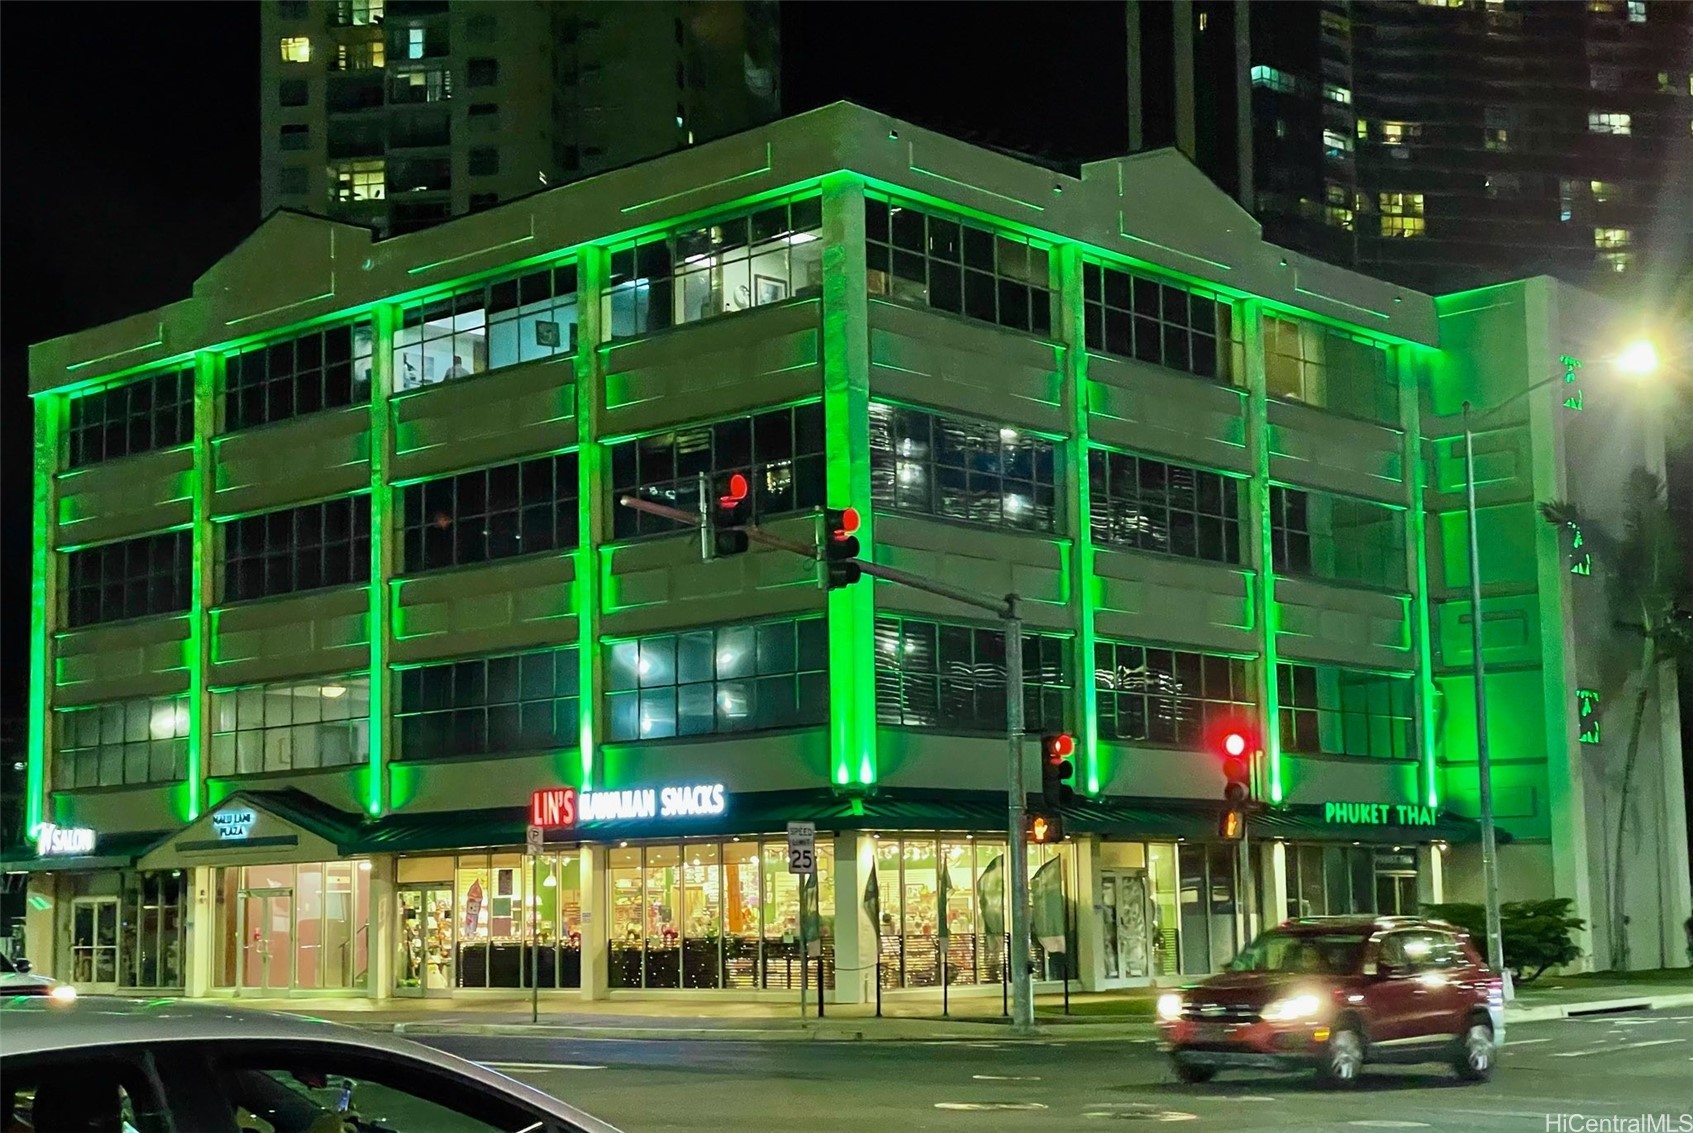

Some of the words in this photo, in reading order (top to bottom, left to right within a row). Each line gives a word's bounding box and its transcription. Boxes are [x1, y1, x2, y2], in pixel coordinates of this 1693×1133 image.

[533, 790, 574, 825] LIN'S
[661, 783, 724, 817] SNACKS
[1325, 802, 1389, 824] PHUKET
[1396, 805, 1436, 826] THAI
[52, 828, 94, 851] SALON
[220, 826, 243, 836] PLAZA
[791, 850, 812, 868] 25
